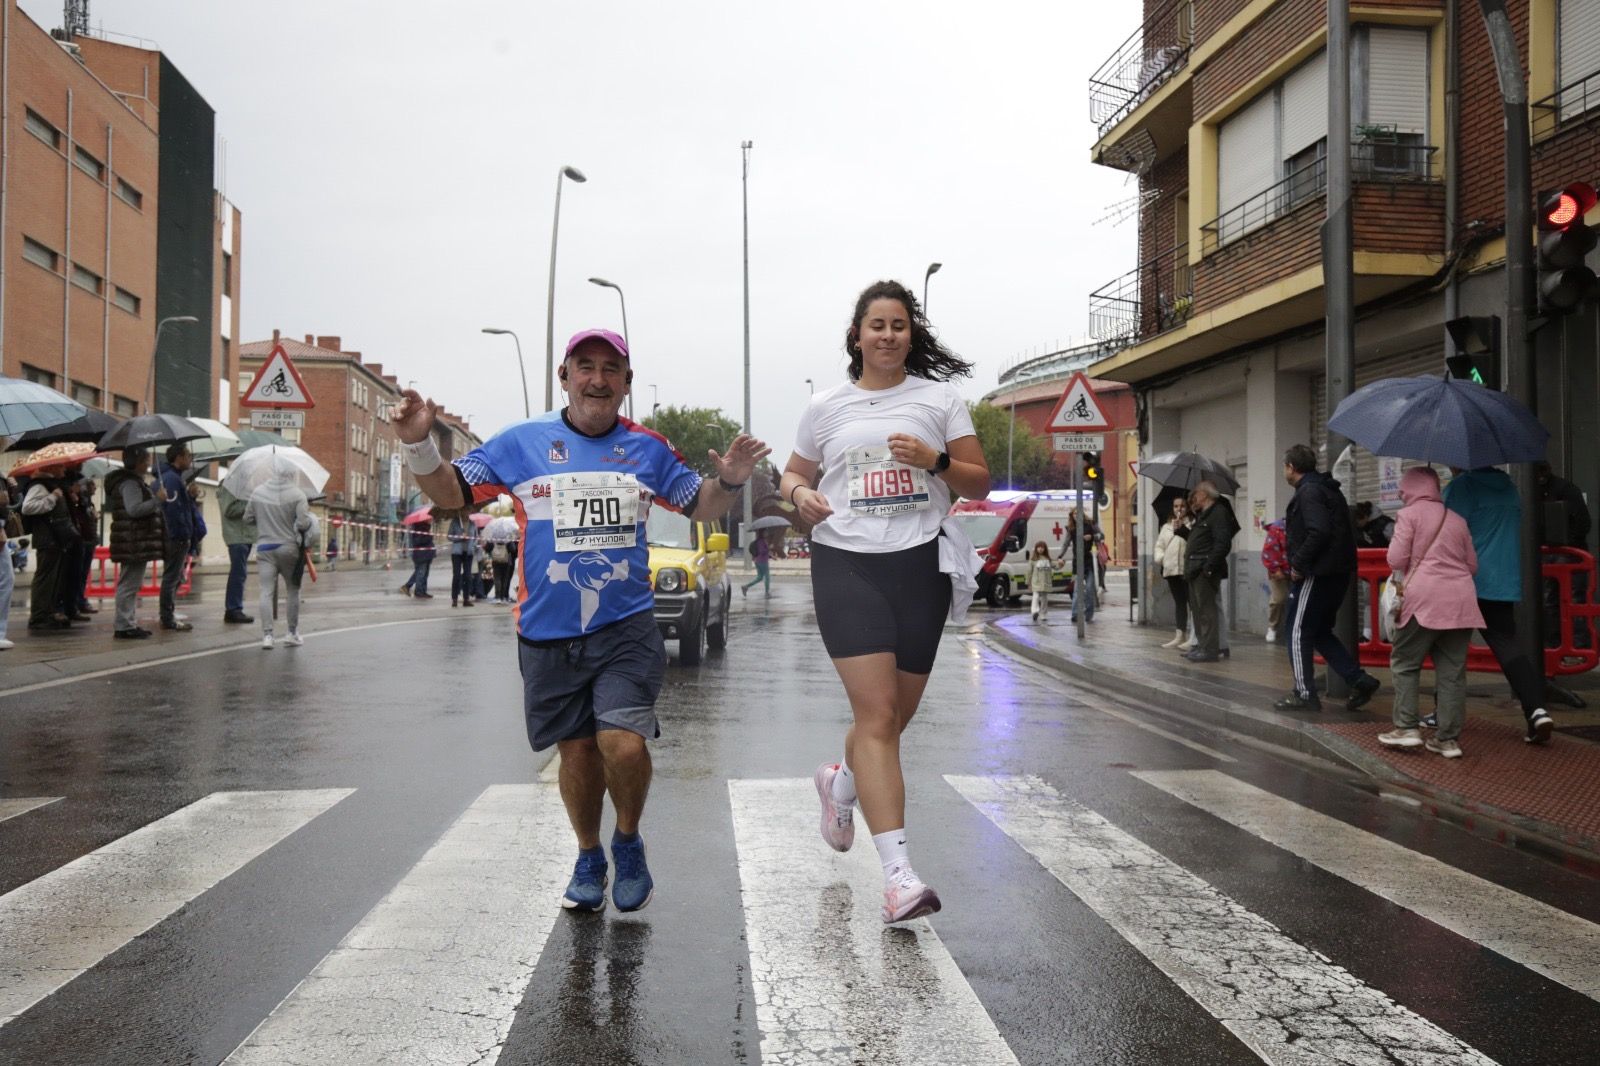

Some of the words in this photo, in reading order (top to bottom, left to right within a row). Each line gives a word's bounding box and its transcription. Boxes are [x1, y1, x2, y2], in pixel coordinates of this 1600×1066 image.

[863, 469, 914, 498] 1099
[573, 497, 621, 527] 790
[880, 503, 917, 513] HYUNDAI
[589, 535, 626, 544] HYUNDAI
